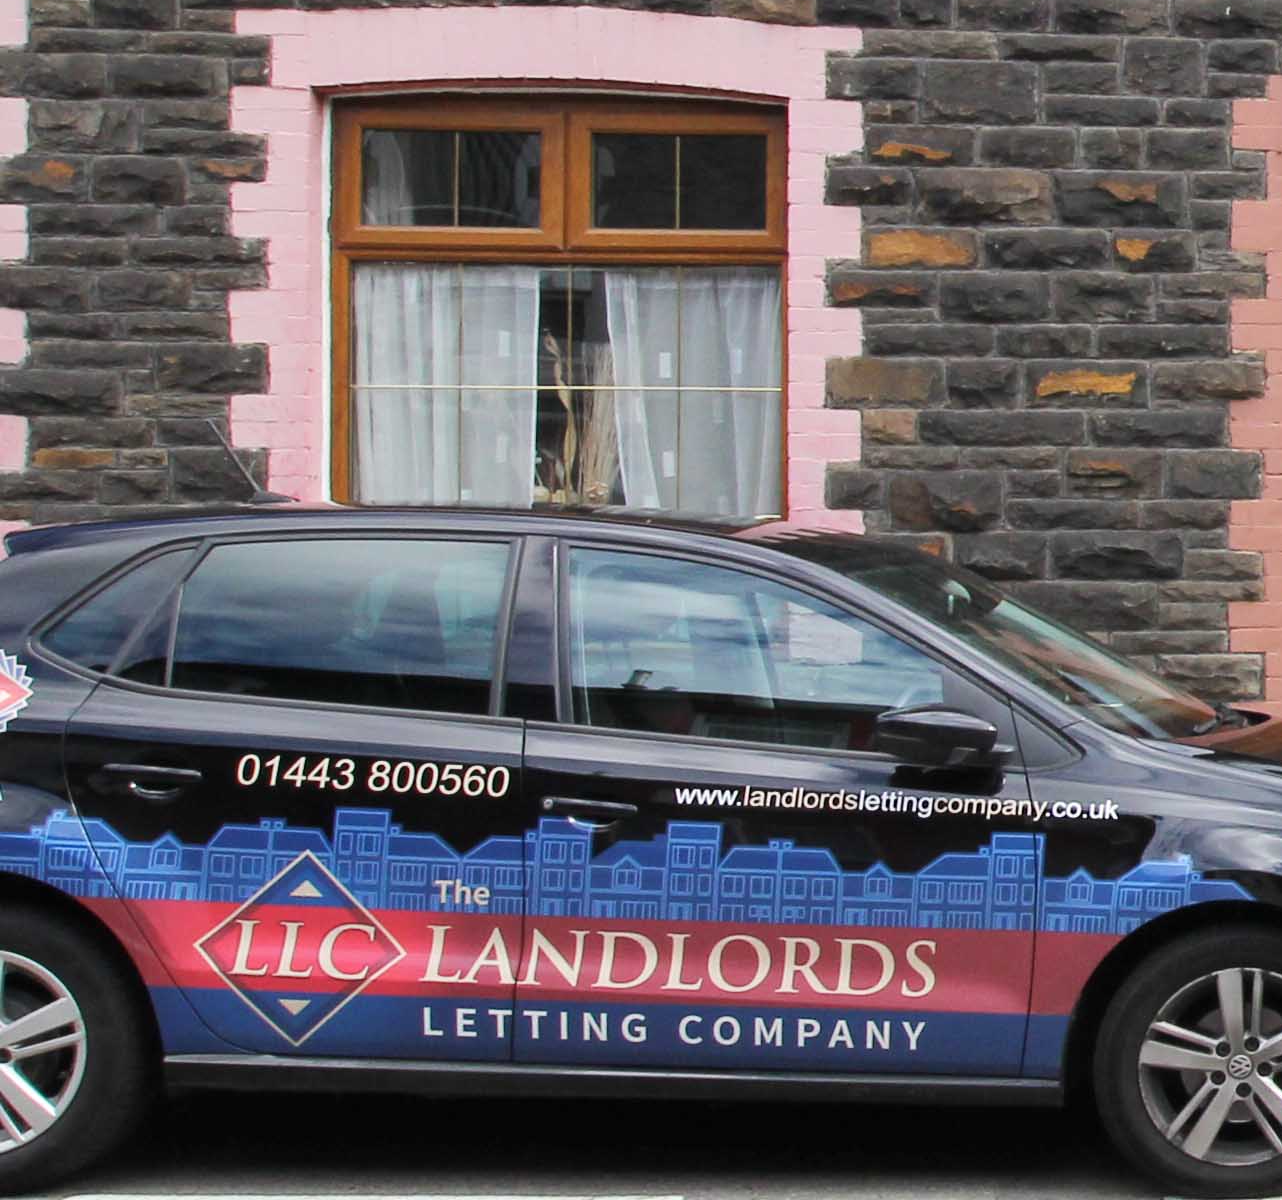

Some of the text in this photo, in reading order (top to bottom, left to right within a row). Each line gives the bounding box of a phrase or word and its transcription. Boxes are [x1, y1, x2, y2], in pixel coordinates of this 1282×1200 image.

[237, 754, 510, 797] 01443 800560
[675, 784, 1120, 822] www.landlordslettingcompany.co.uk
[434, 878, 490, 906] The
[229, 919, 375, 980] LLC
[418, 925, 936, 997] LANDLORDS
[423, 1007, 926, 1050] LETTING COMPANY
